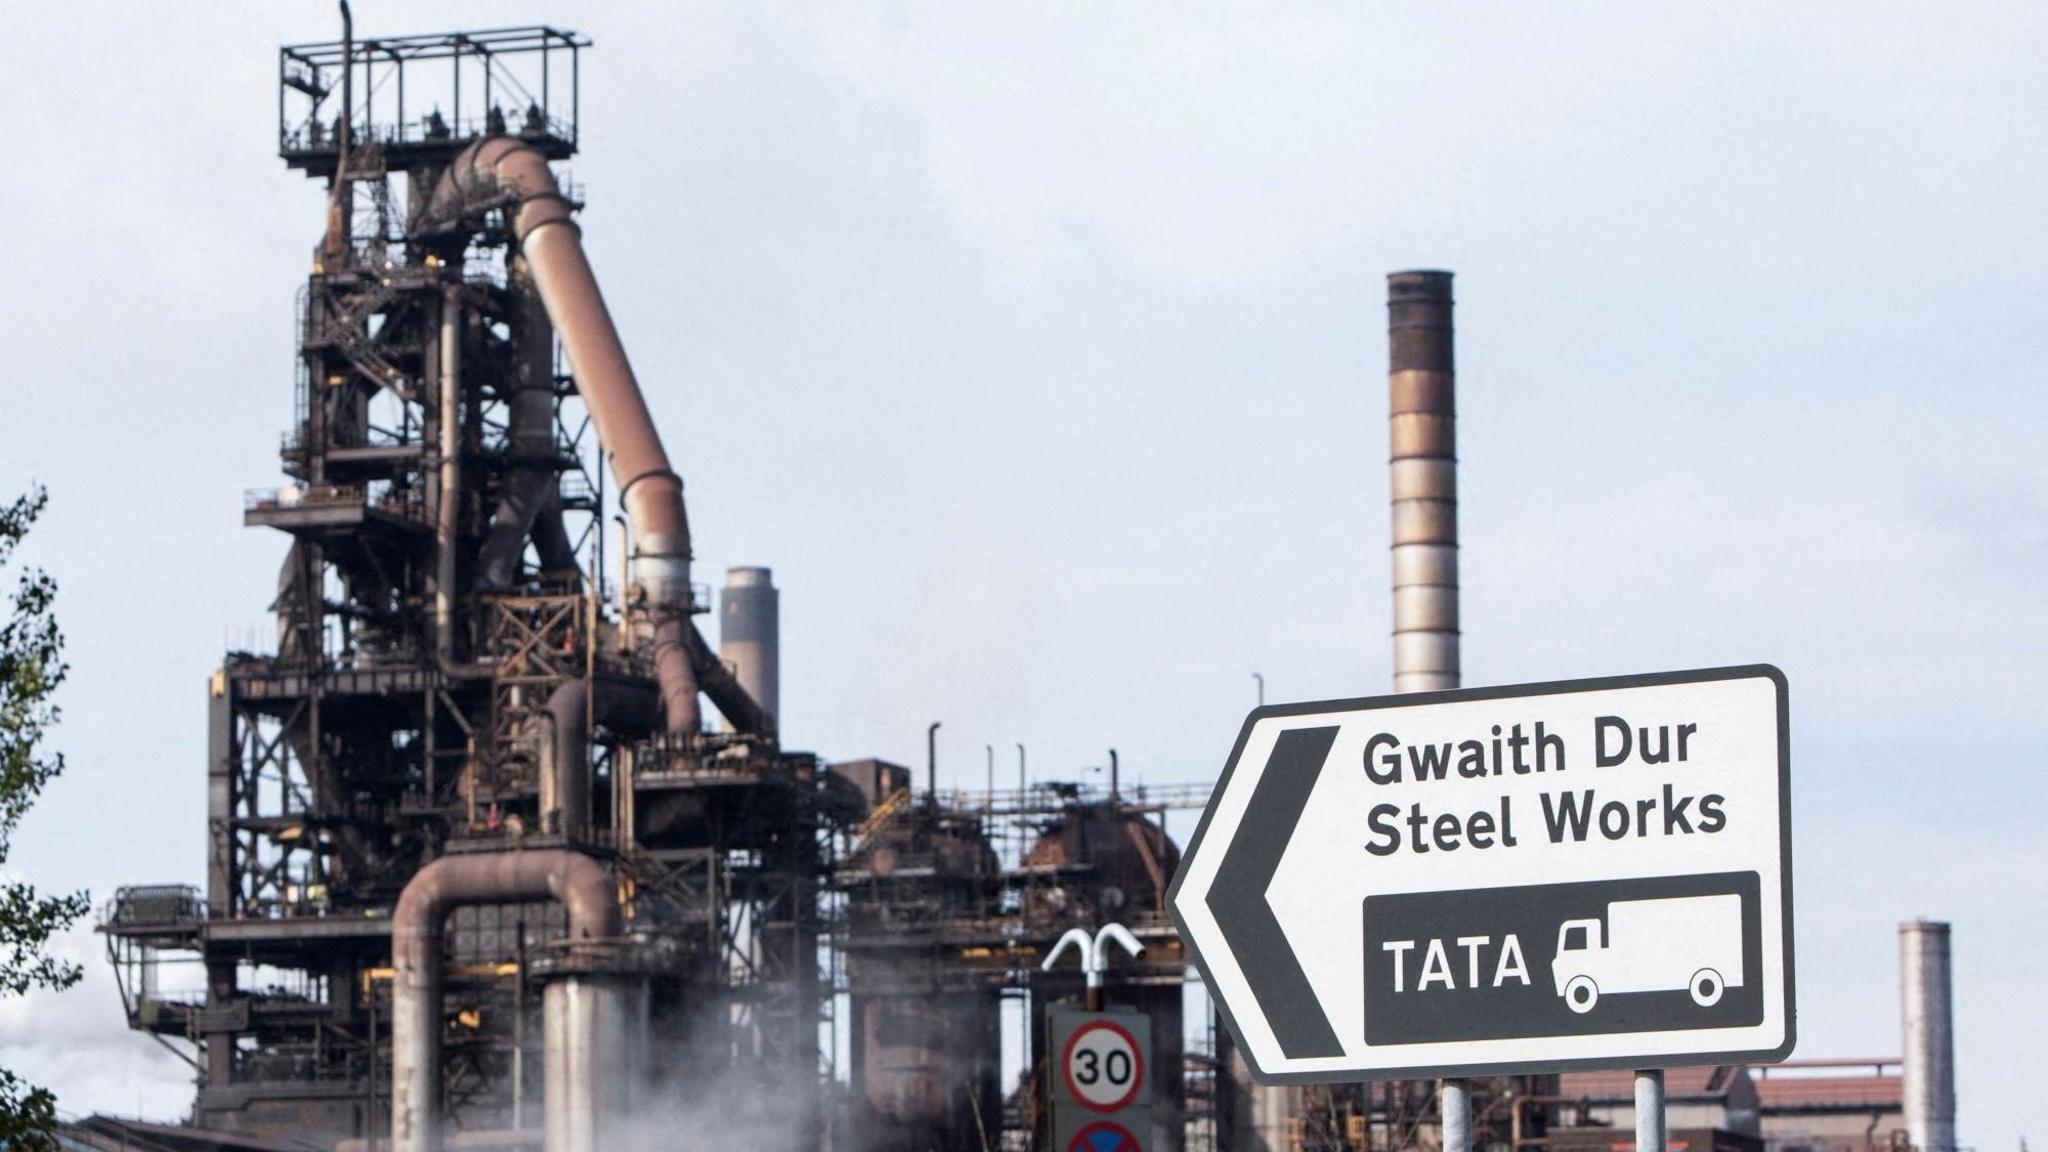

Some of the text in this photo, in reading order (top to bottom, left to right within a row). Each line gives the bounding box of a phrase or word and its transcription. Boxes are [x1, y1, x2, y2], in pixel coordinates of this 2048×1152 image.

[1363, 715, 1698, 786] Gwaith Dur
[1364, 783, 1727, 857] Steel Works
[1382, 933, 1532, 993] TATA
[1075, 1048, 1132, 1086] 30
